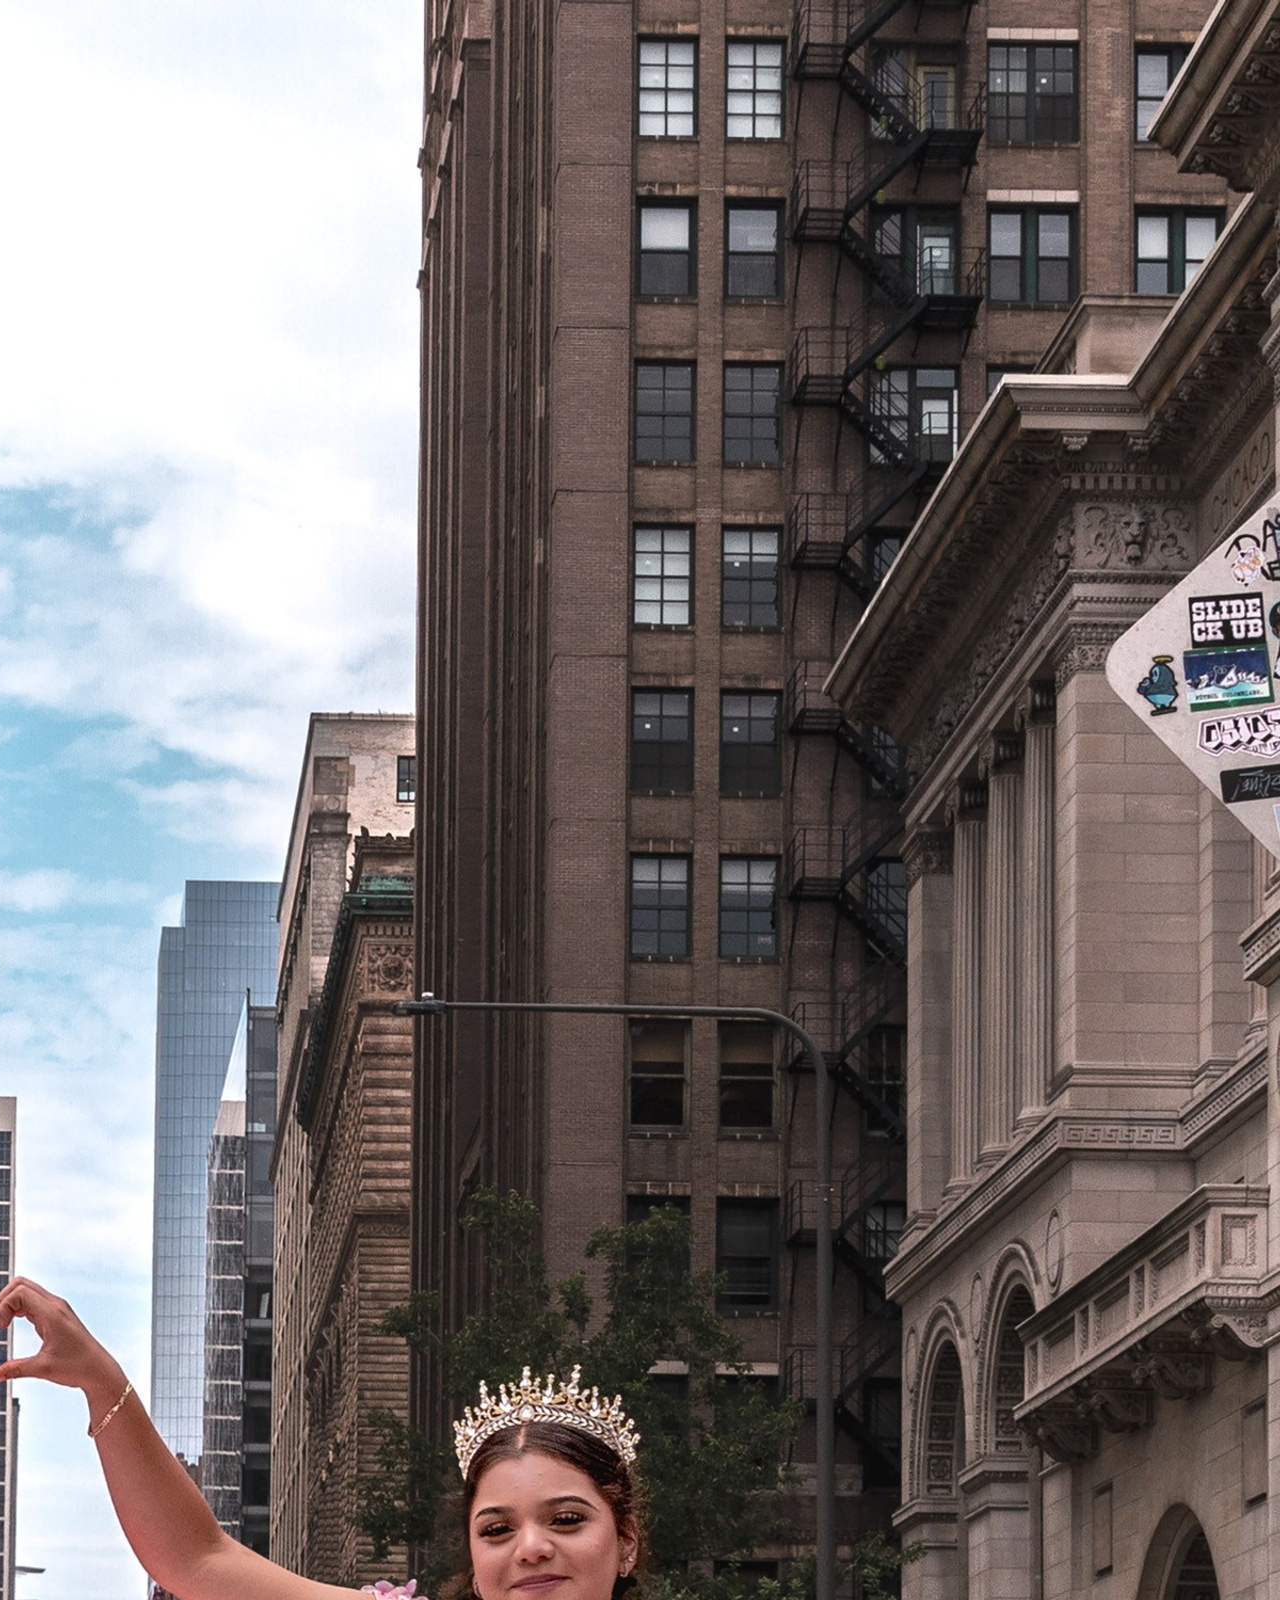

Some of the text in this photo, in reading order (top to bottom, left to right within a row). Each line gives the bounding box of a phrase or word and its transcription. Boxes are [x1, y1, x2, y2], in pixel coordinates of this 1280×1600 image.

[1211, 431, 1271, 534] CHICAGO
[1191, 598, 1262, 622] SLIDE
[1192, 619, 1263, 642] CK UB
